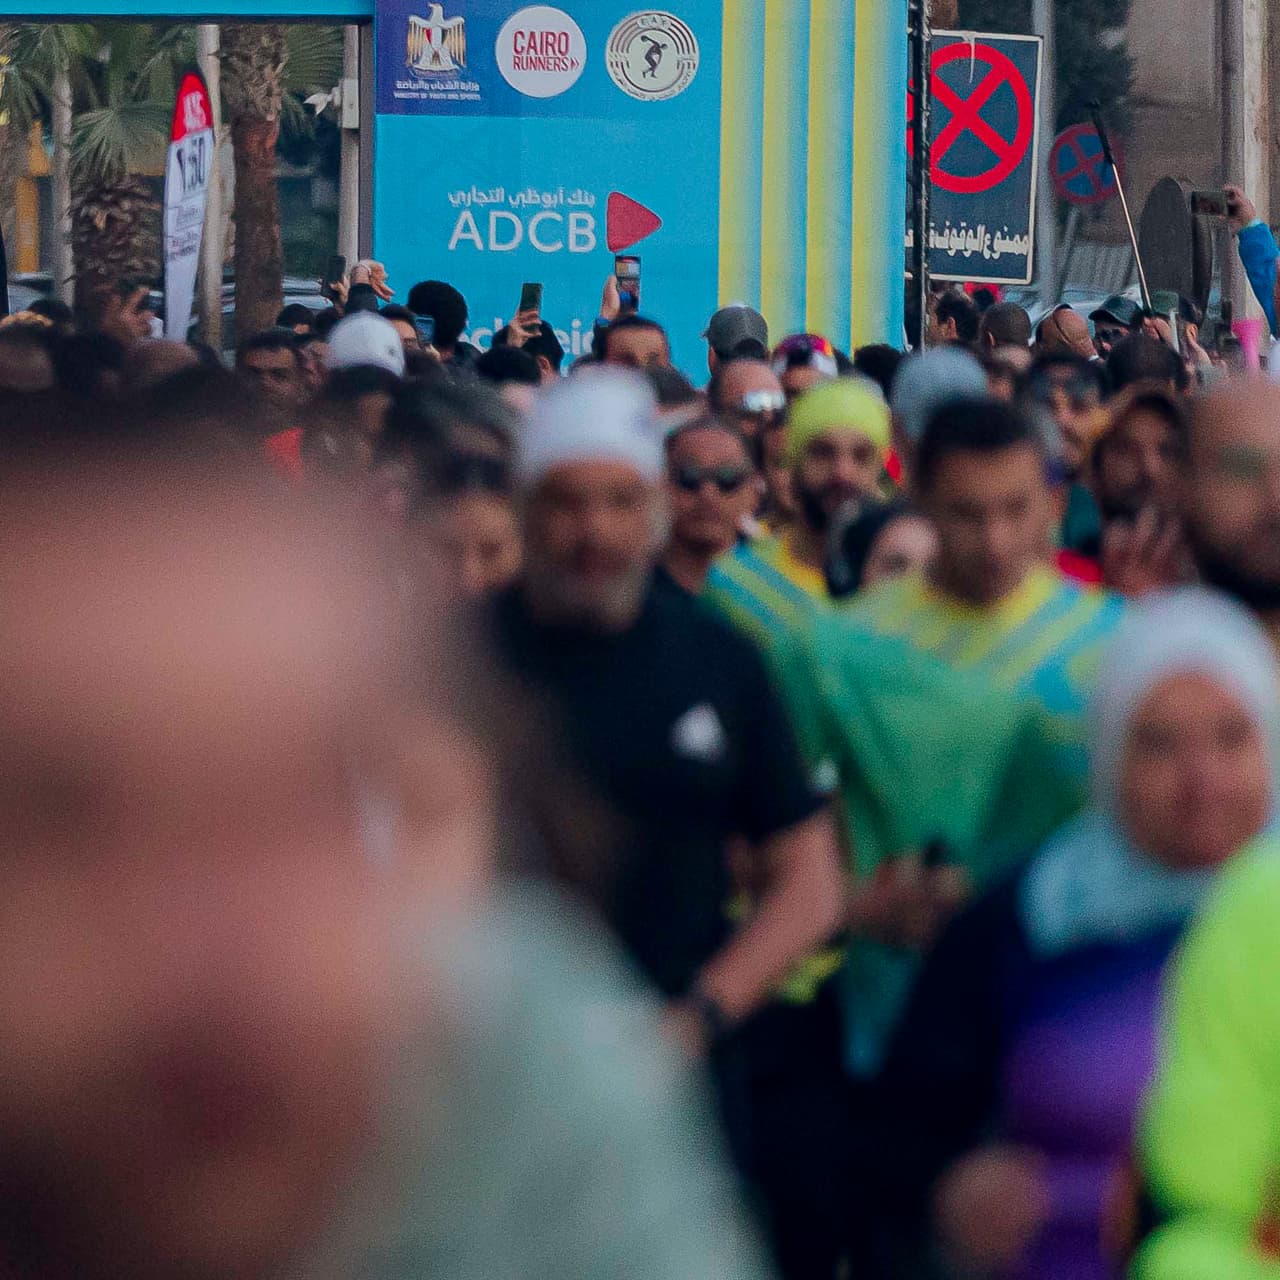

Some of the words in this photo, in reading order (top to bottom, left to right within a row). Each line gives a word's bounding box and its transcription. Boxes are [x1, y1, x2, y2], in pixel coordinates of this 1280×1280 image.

[513, 30, 570, 56] CAIRO
[512, 56, 569, 72] RUNNERS
[448, 184, 505, 208] التجاري
[508, 185, 564, 208] أبوظبي
[568, 188, 596, 208] بنك
[447, 209, 596, 253] ADCB
[983, 225, 1029, 259] ممنوع
